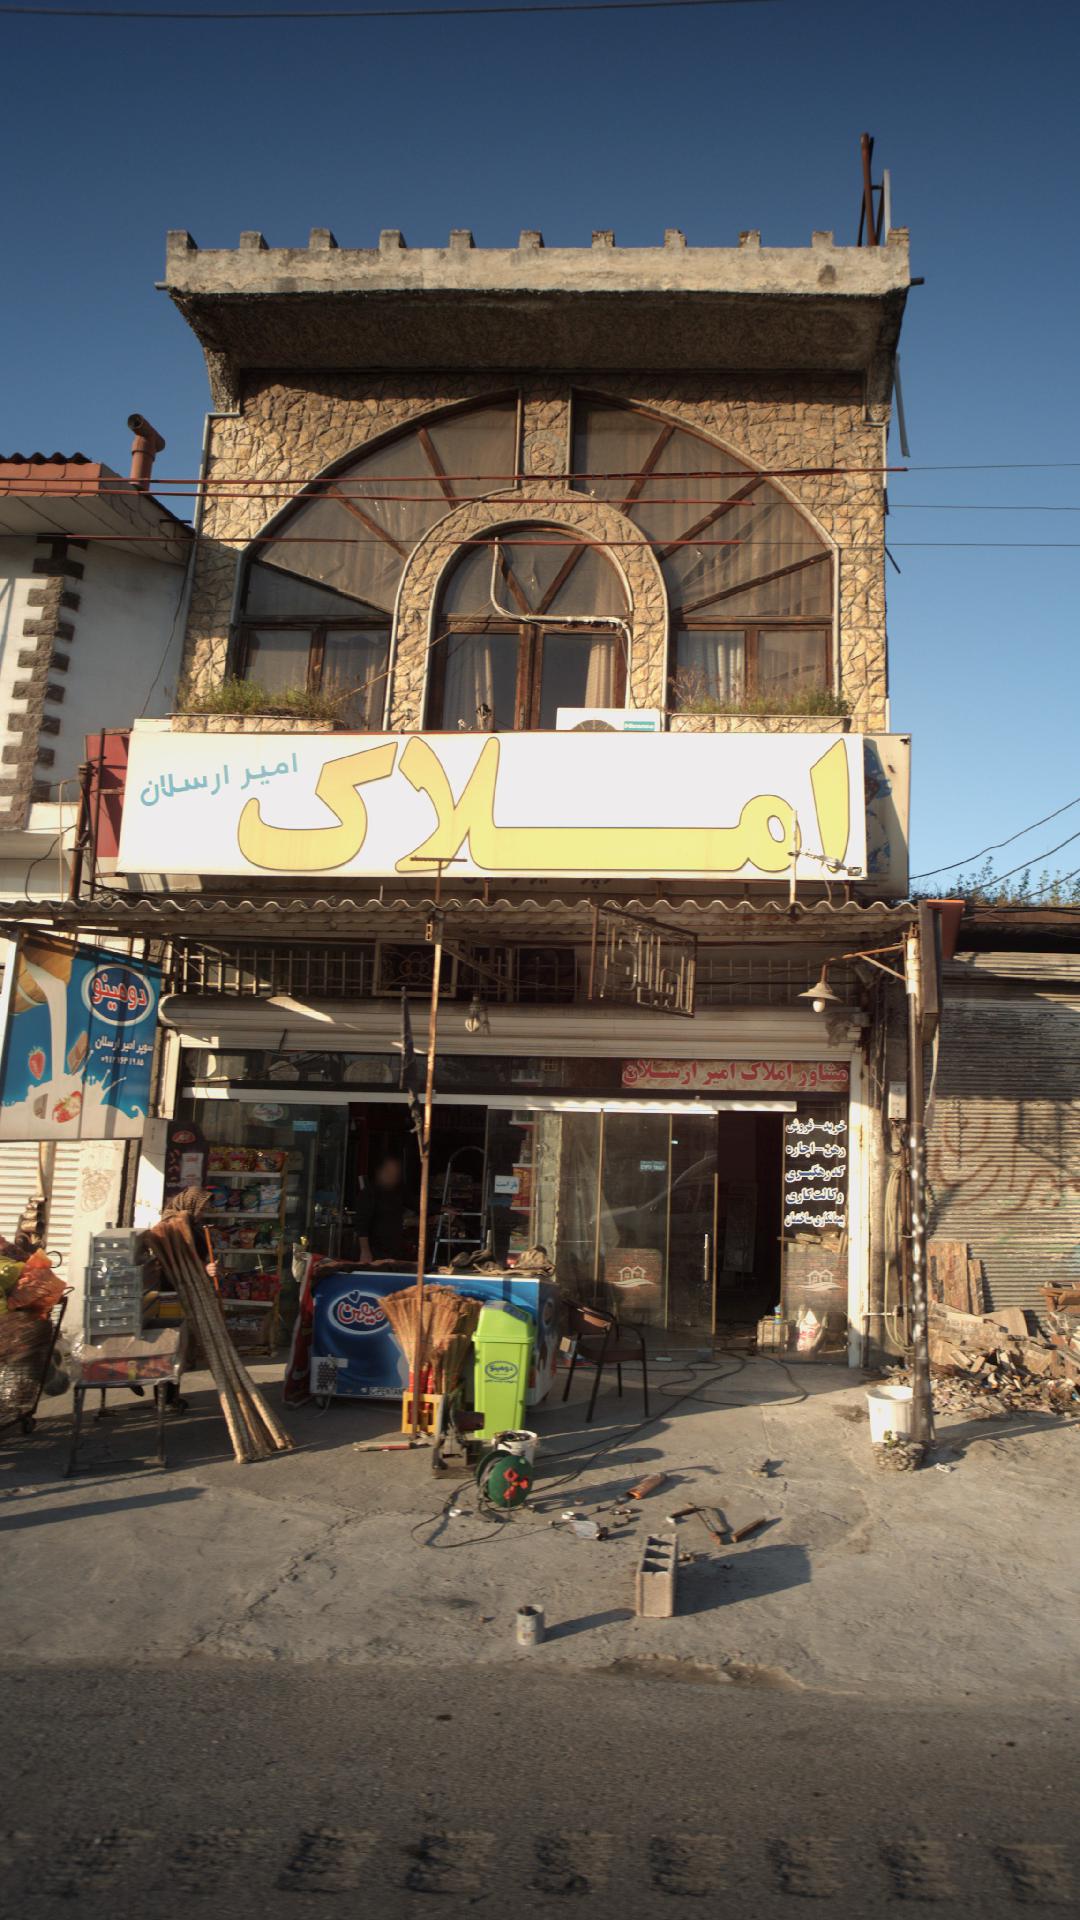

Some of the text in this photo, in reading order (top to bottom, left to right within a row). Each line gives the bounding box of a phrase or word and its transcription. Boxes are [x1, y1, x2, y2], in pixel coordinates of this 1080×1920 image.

[140, 752, 299, 807] امیر ارسلان
[238, 735, 851, 873] املاک
[92, 973, 147, 1011] دومینو
[622, 1059, 848, 1087] مشاور املاک امیر ارسلان
